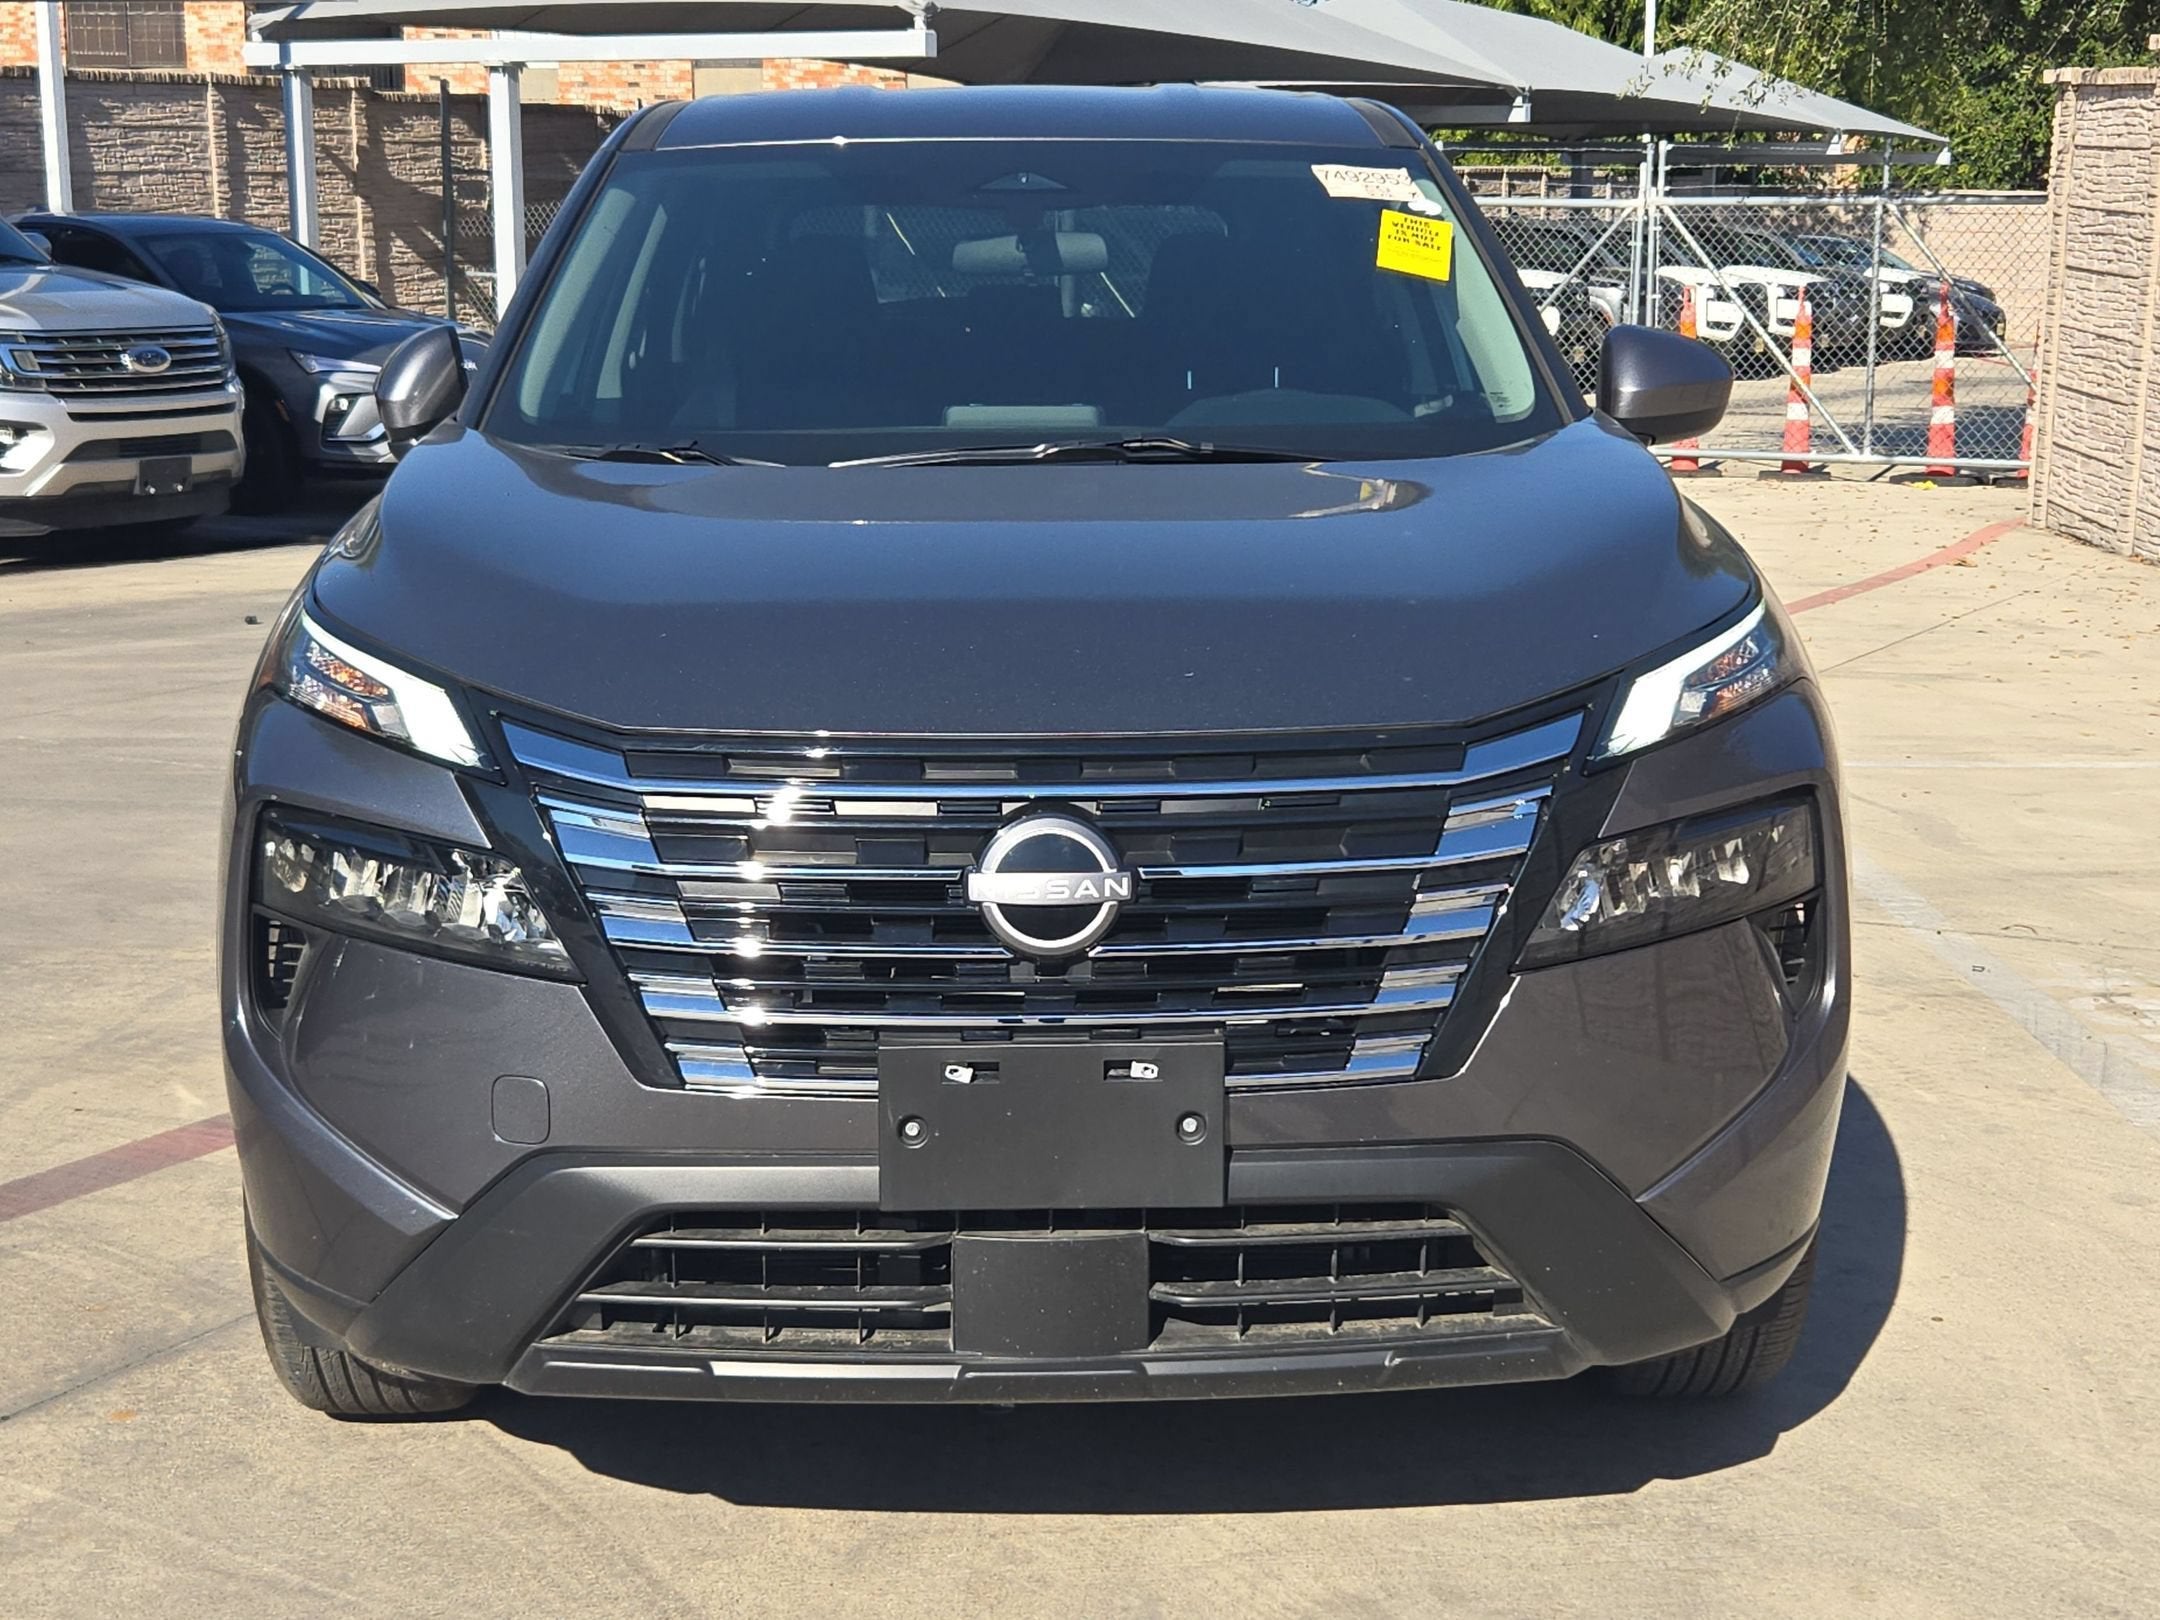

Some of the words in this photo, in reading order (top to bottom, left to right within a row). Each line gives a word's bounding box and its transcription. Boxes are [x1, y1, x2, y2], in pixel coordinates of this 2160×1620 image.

[1391, 220, 1440, 237] VEHICLE
[1404, 217, 1430, 229] THIS
[1387, 234, 1410, 244] FOR
[1414, 239, 1441, 251] SALE
[1395, 228, 1407, 237] IS
[1411, 232, 1435, 243] NOT
[973, 877, 1129, 900] NISSAN
